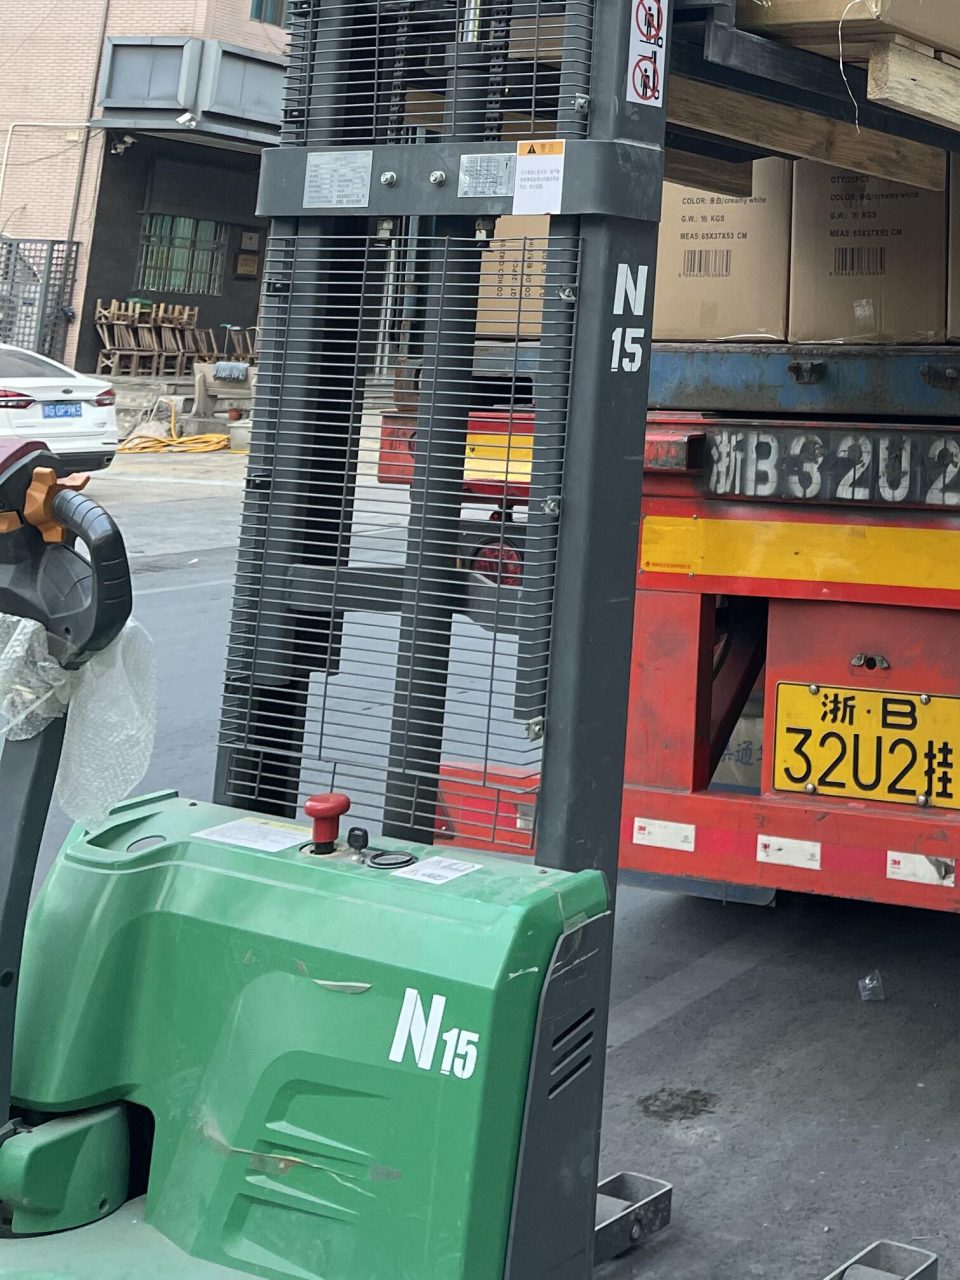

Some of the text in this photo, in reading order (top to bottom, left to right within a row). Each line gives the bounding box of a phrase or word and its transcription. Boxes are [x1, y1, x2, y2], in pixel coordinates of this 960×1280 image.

[737, 232, 748, 240] CM
[891, 228, 902, 236] CM
[613, 263, 649, 316] N
[610, 327, 645, 372] 15
[783, 727, 954, 799] 32U2挂
[637, 825, 647, 833] 3M
[890, 858, 901, 866] 3M
